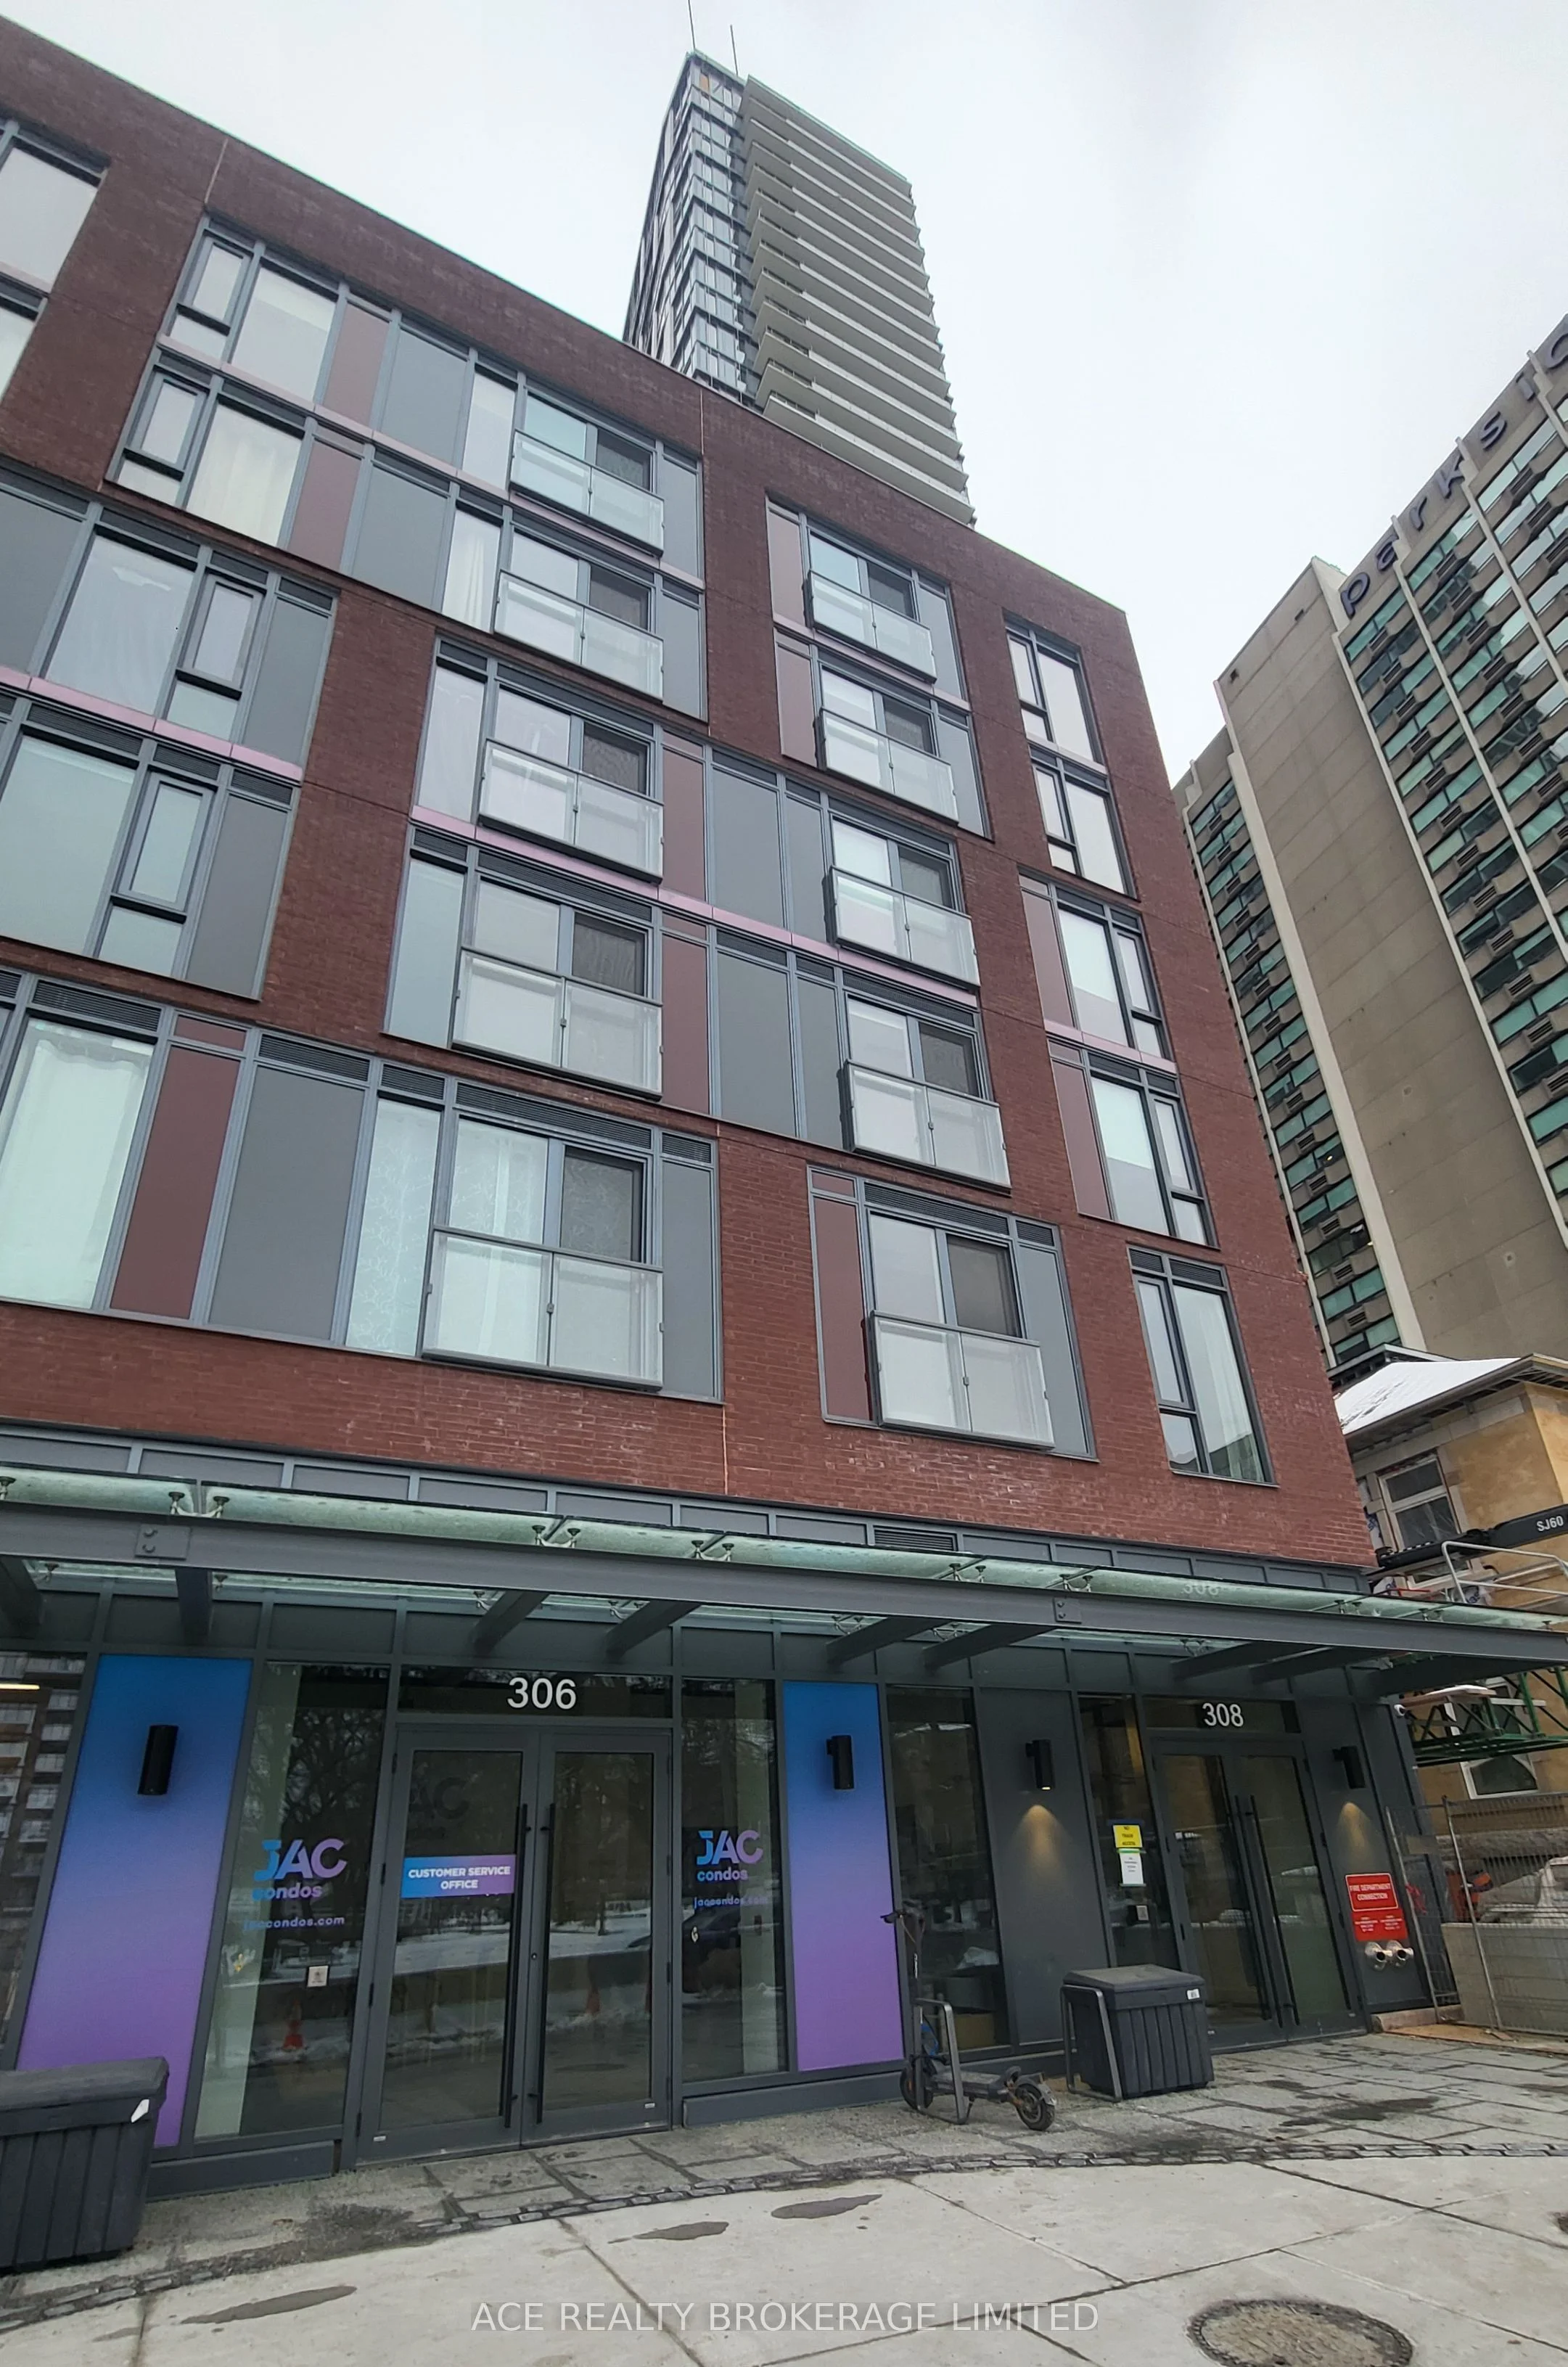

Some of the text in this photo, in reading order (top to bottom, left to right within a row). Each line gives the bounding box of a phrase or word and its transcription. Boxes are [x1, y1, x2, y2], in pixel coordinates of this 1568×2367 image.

[1536, 1516, 1564, 1531] SJ60
[507, 1677, 576, 1710] 306
[1202, 1702, 1244, 1727] 308
[697, 1829, 763, 1865] JAC
[253, 1838, 348, 1882] JAC
[408, 1866, 511, 1879] CUSTOMER SERVICE
[697, 1866, 748, 1882] condos
[440, 1879, 479, 1890] OFFICE
